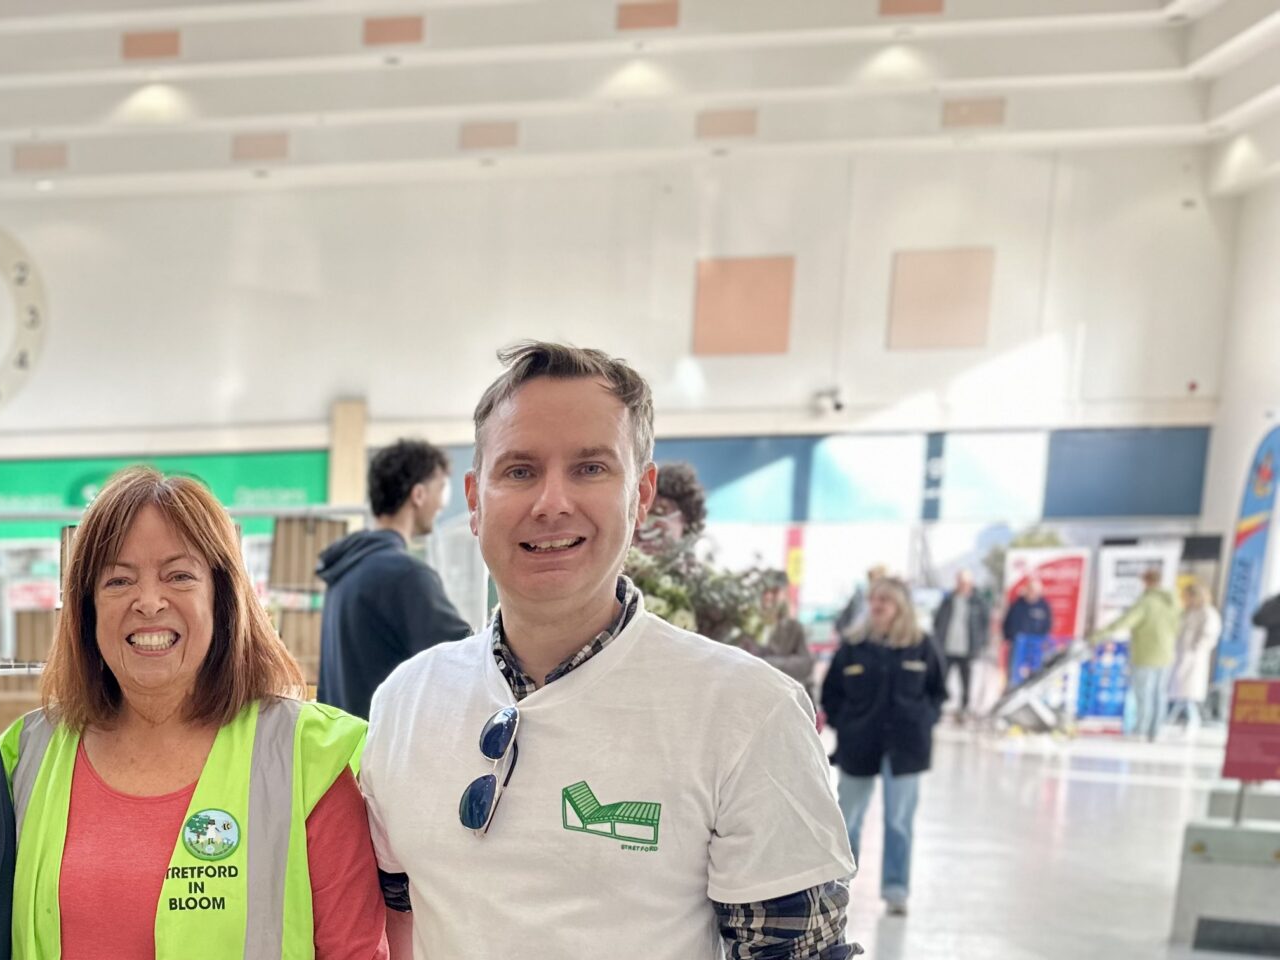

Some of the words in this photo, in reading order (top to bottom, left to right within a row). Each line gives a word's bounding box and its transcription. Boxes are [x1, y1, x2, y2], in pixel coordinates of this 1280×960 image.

[14, 260, 30, 287] 2
[25, 304, 41, 330] 3
[165, 865, 239, 880] TRETFORD
[188, 881, 205, 894] IN
[168, 897, 226, 911] BLOOM
